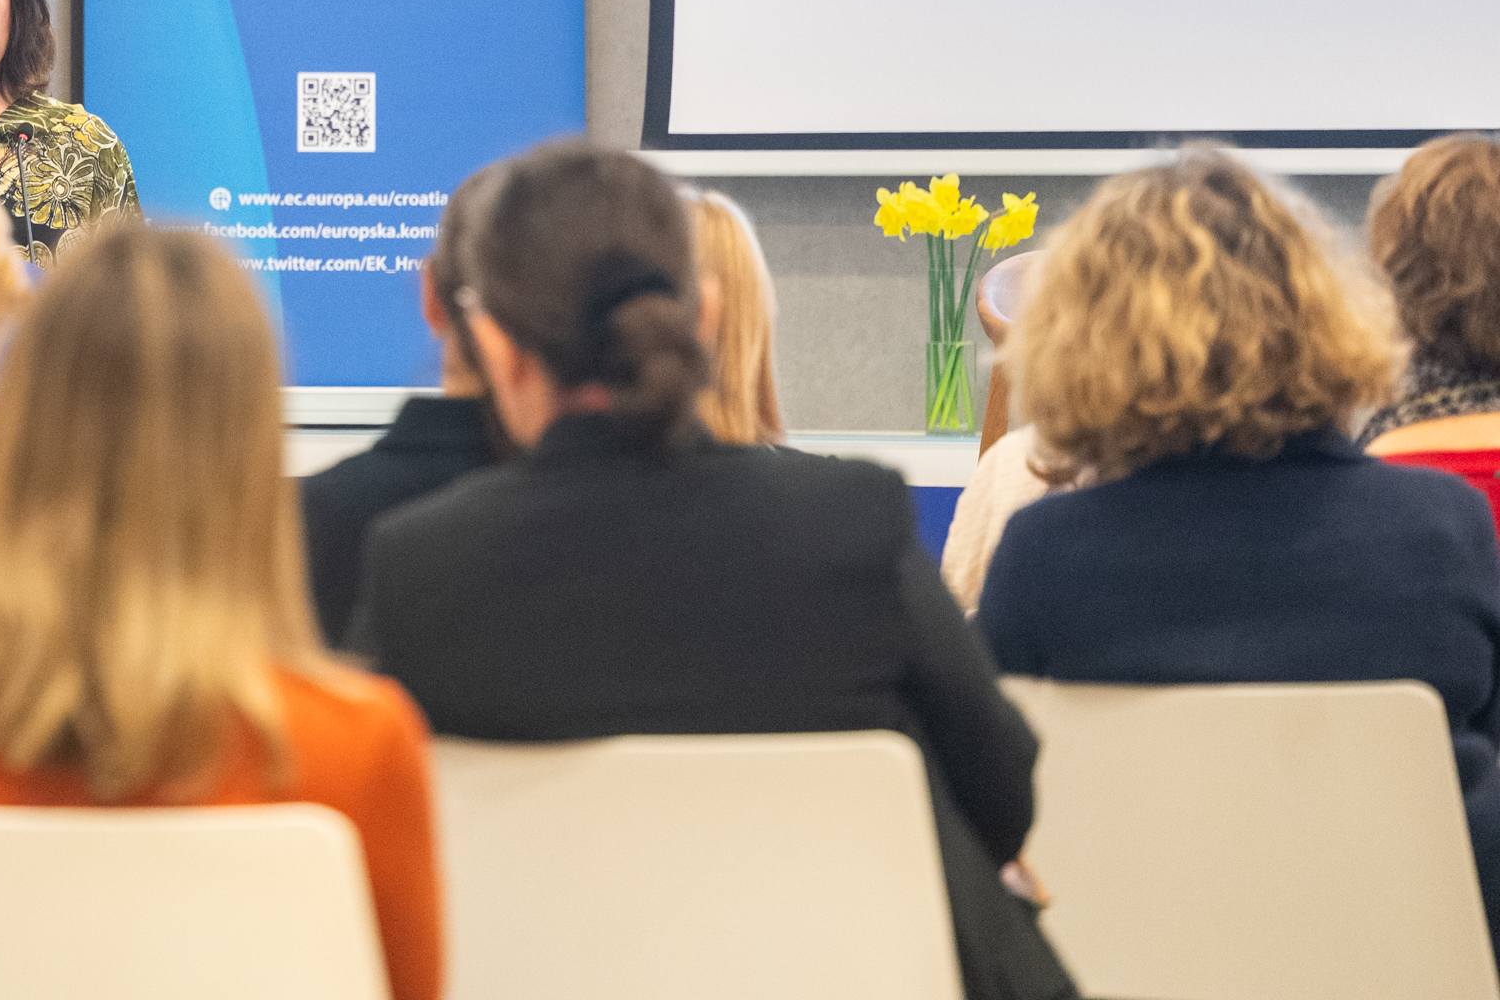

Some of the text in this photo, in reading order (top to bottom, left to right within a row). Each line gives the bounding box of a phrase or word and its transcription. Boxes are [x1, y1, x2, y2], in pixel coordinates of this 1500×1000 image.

[238, 189, 449, 210] www.ec.europa.eu/croatia
[154, 221, 444, 242] facebook.com/europska.komi
[234, 255, 426, 274] ww.twitter.com/EK_Hrv
